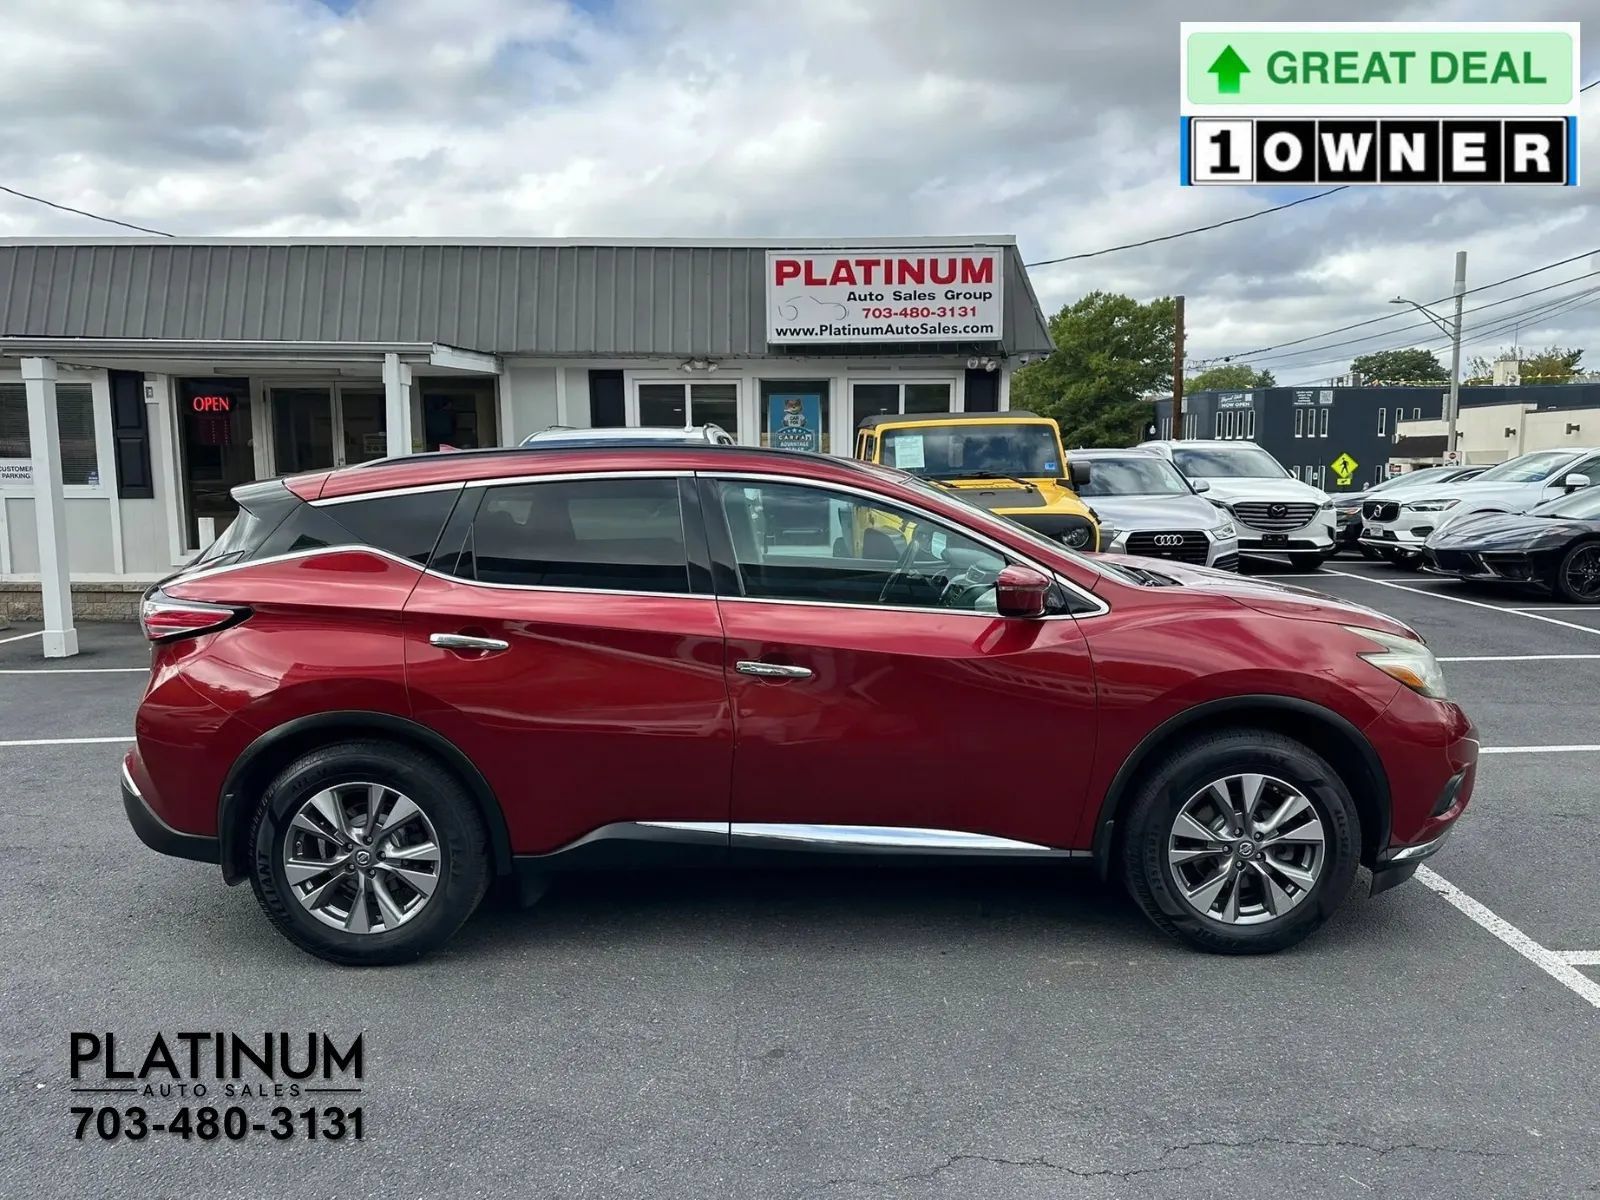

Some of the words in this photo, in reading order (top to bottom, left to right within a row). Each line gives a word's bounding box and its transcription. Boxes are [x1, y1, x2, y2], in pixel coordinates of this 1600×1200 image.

[775, 257, 993, 286] PLATINUM
[846, 291, 884, 302] Auto
[892, 290, 936, 301] Sales
[944, 290, 993, 302] Group
[862, 306, 977, 319] 703-480-3131
[775, 322, 994, 337] www.PlatinumAutoSales.com
[193, 396, 229, 411] OPEN
